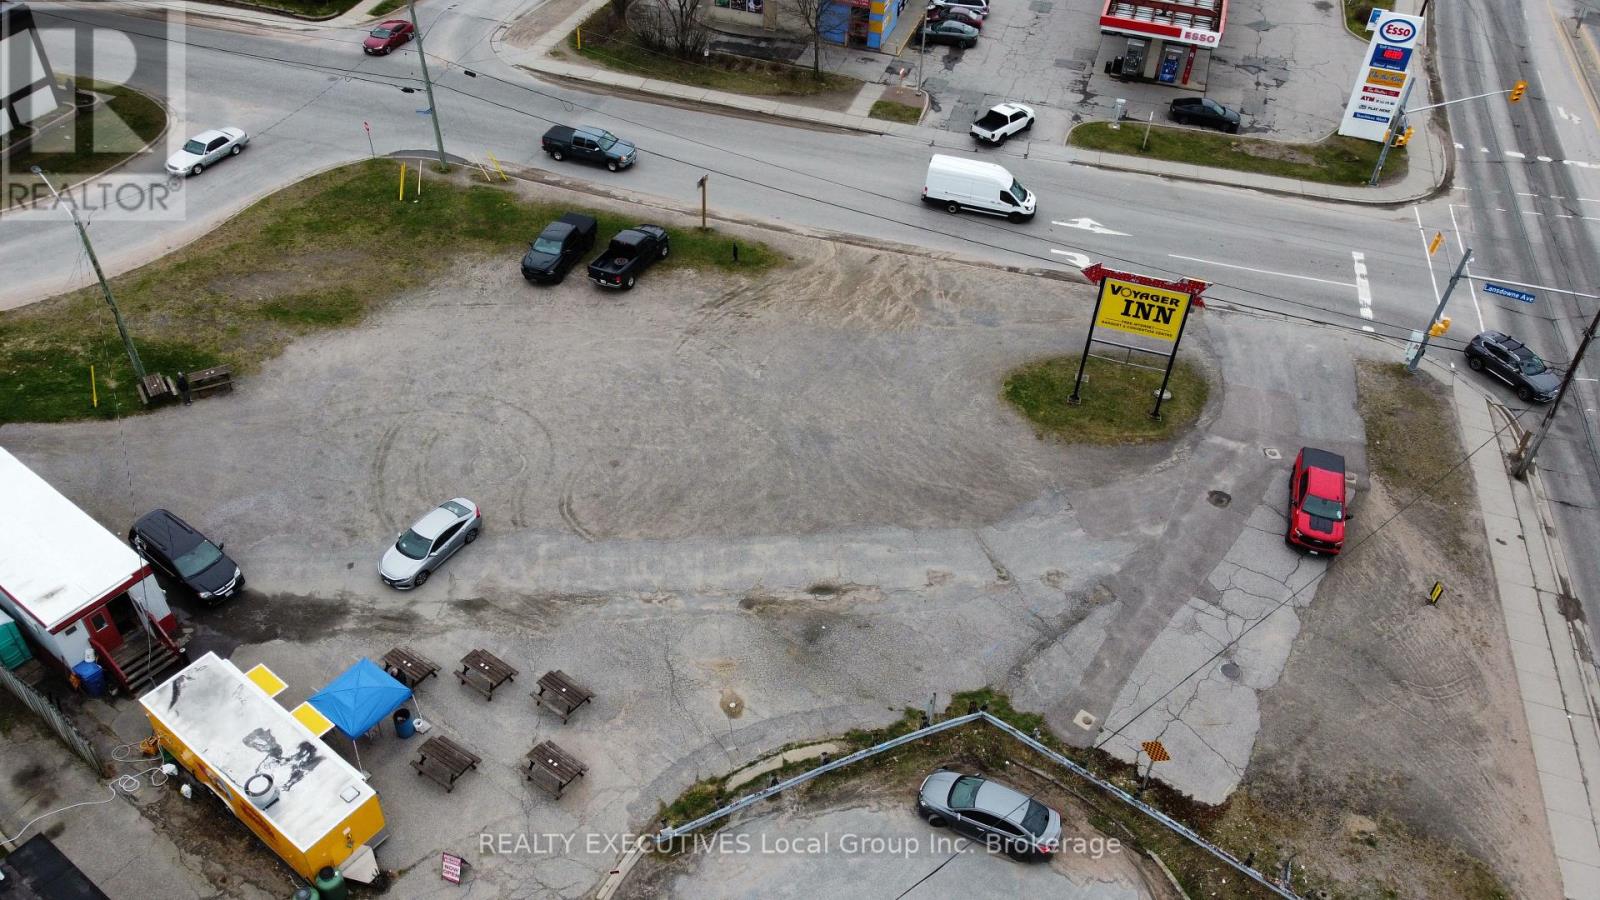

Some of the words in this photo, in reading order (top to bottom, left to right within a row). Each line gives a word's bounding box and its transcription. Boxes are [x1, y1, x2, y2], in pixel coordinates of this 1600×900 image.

[1184, 31, 1216, 43] ESSO
[1110, 284, 1180, 307] VOYAGER
[1484, 284, 1519, 298] Lansdowne
[1520, 294, 1534, 302] Ave
[1120, 299, 1176, 325] INN
